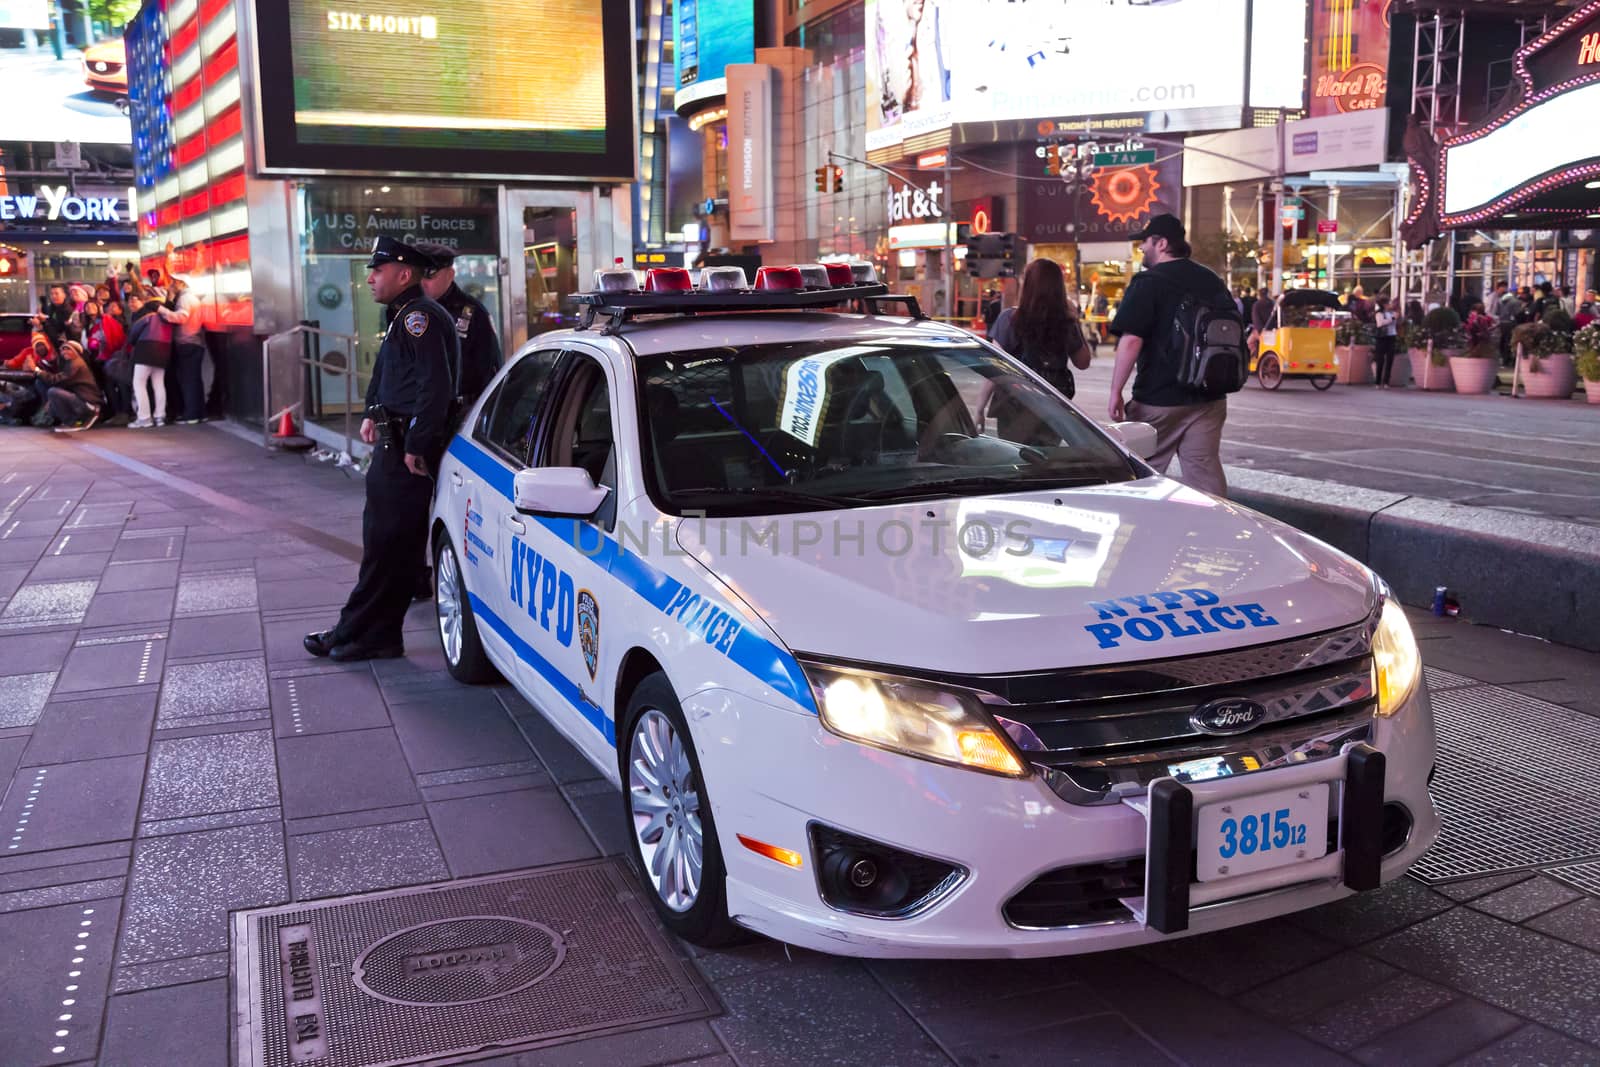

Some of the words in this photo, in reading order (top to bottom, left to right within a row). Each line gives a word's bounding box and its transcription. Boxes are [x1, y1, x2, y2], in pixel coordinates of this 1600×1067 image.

[328, 11, 362, 31] SIX
[1315, 73, 1364, 97] Hard
[1349, 99, 1377, 110] CAFE
[1058, 120, 1102, 131] THOMSON
[1103, 117, 1145, 129] REUTERS
[1111, 154, 1118, 163] 7
[40, 185, 120, 222] YORK
[893, 180, 943, 221] at&t
[325, 213, 361, 230] U.S.
[510, 535, 575, 648] NYPD
[1088, 588, 1220, 620] NYPD
[667, 585, 738, 655] POLICE
[1084, 603, 1280, 649] POLICE
[1214, 704, 1254, 727] Ford
[1218, 808, 1290, 859] 3815
[1291, 823, 1306, 846] 12
